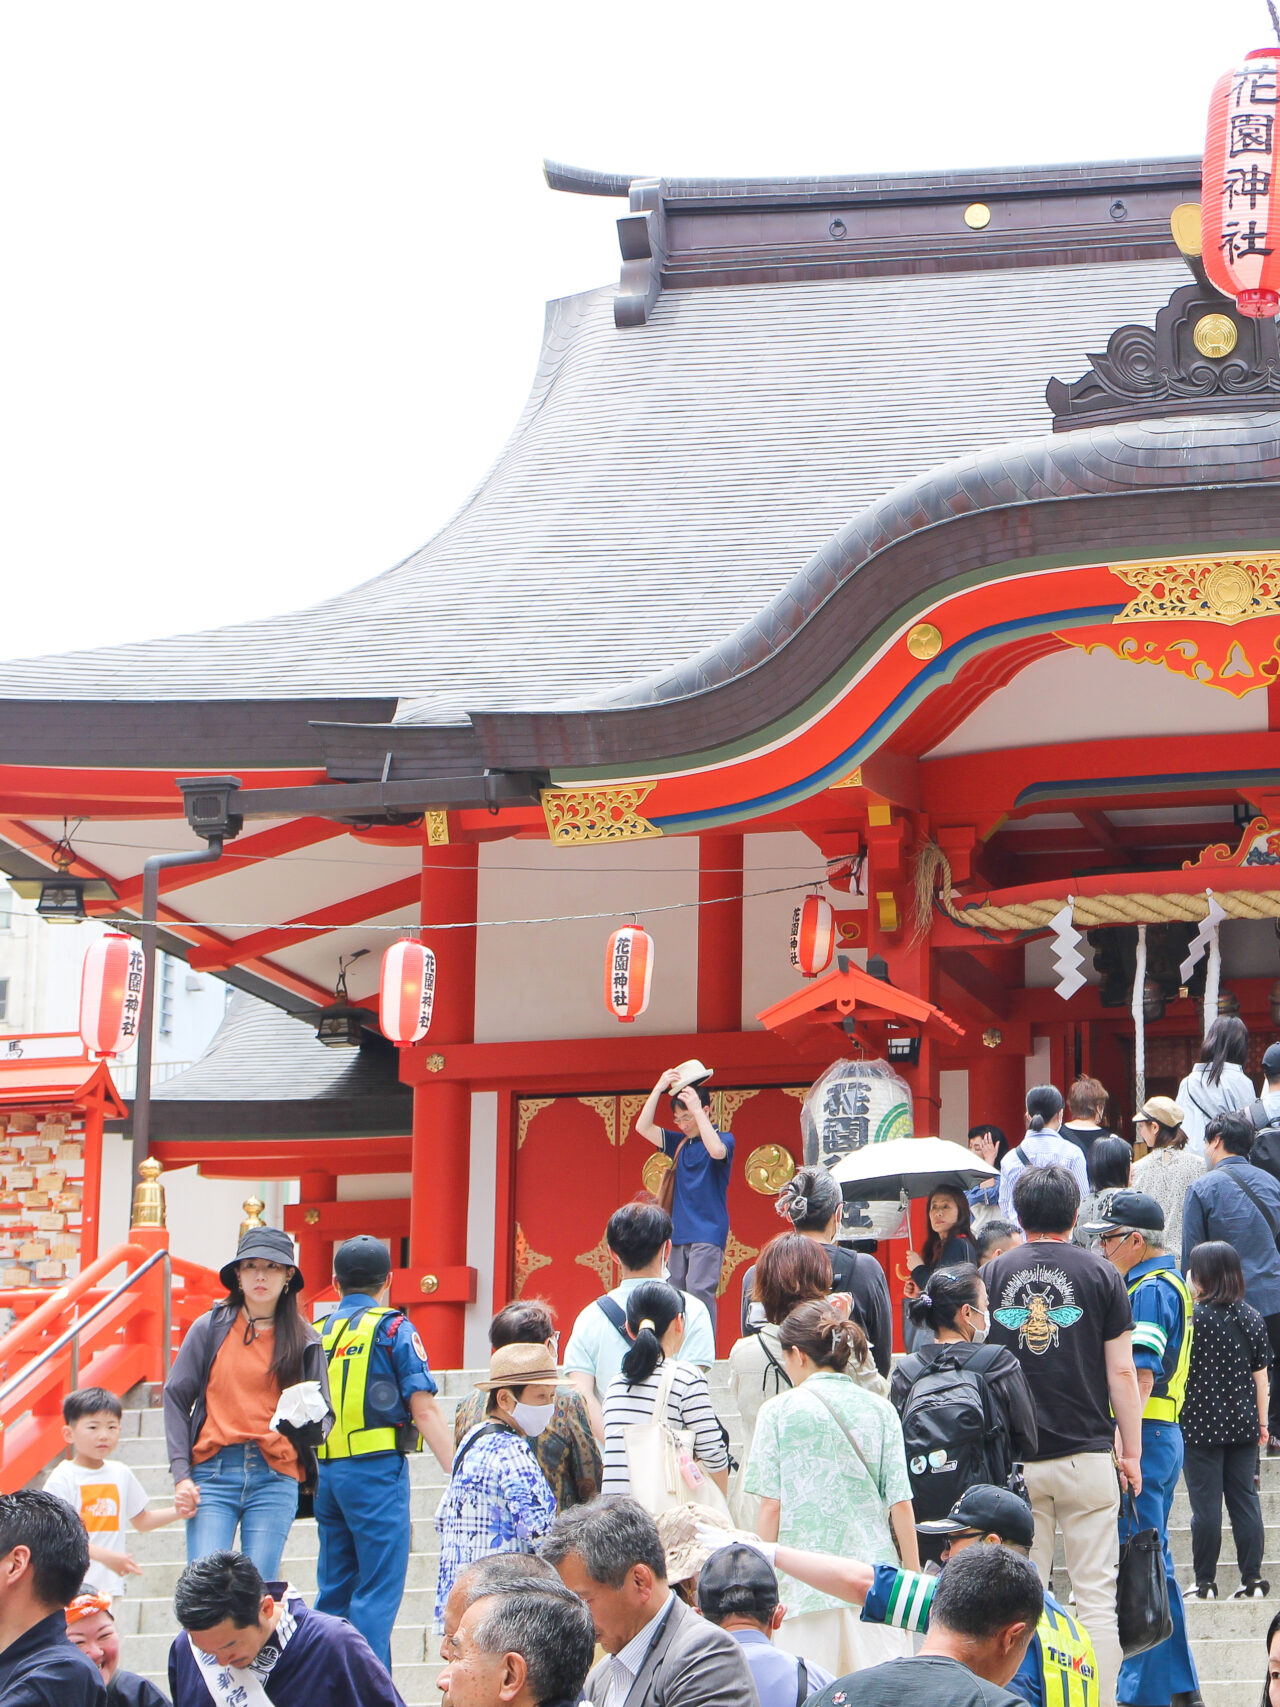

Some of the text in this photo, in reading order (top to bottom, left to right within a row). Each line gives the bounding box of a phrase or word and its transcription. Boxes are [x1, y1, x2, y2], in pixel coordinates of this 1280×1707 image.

[1219, 65, 1280, 265] 花園神社
[122, 950, 143, 1036] 花園神社
[419, 953, 435, 1029] 花園神社
[613, 937, 631, 1007] 花園神社
